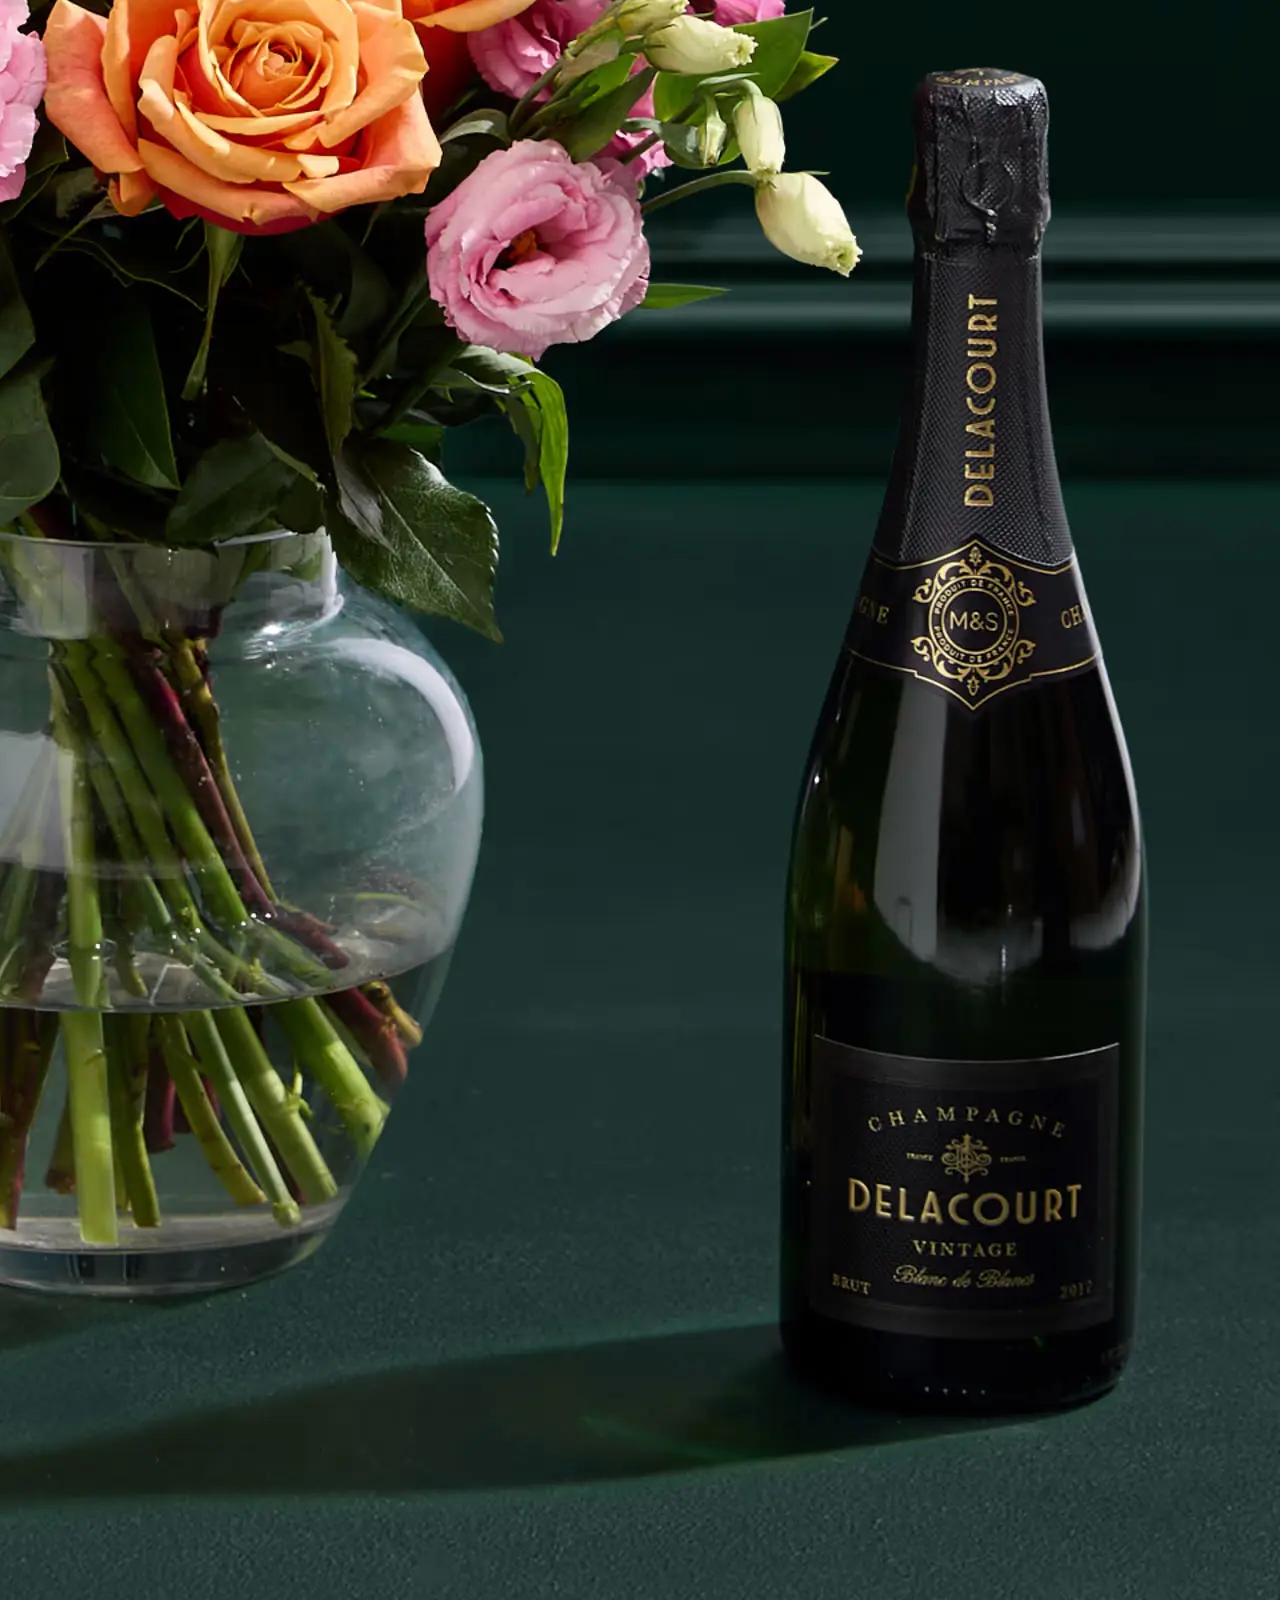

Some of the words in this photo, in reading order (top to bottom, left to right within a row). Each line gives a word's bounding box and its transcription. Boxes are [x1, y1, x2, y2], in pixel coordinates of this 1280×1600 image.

[963, 293, 999, 508] DELACOURT
[934, 580, 966, 615] PRODUIT
[970, 579, 984, 587] DE
[987, 582, 1015, 616] FRANCE
[950, 611, 999, 632] M&S
[934, 625, 966, 660] PRODUIT
[969, 655, 983, 663] DE
[985, 628, 1014, 659] FRANCE
[868, 1106, 1066, 1138] CHAMPAGNE
[848, 1177, 1082, 1227] DELACOURT
[912, 1239, 1018, 1258] VINTAGE
[832, 1273, 872, 1296] BRUT
[892, 1264, 948, 1287] Blanc
[952, 1271, 971, 1288] de
[976, 1268, 1036, 1288] Blancs
